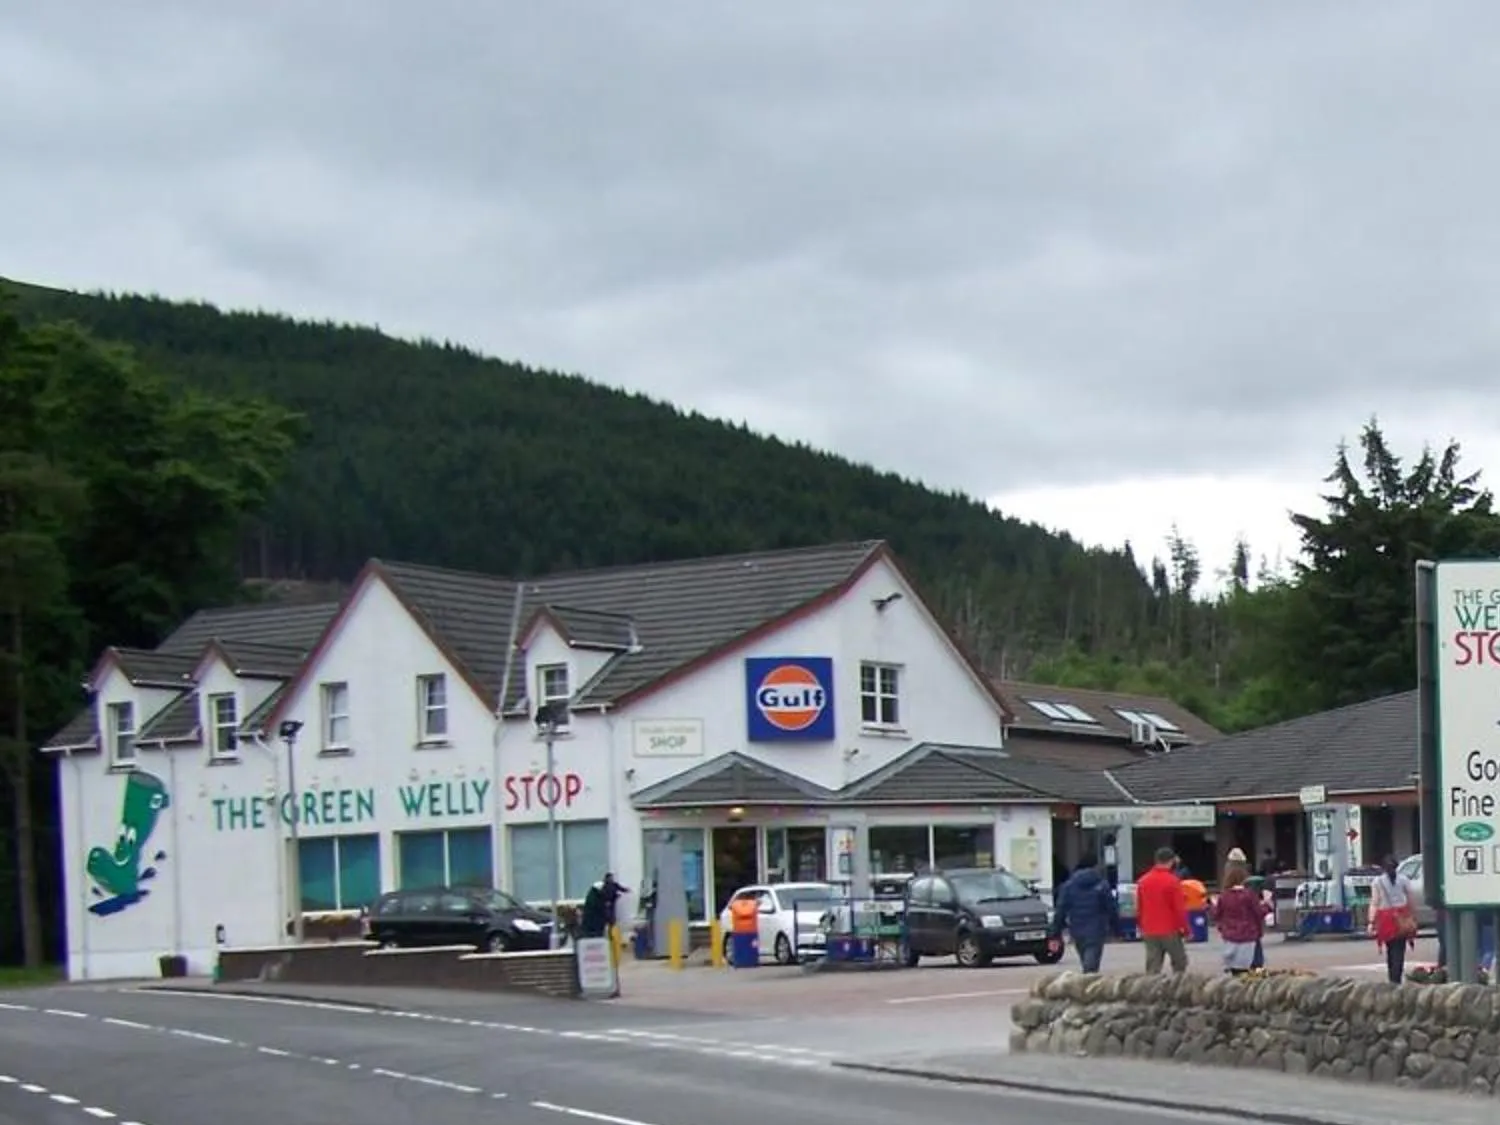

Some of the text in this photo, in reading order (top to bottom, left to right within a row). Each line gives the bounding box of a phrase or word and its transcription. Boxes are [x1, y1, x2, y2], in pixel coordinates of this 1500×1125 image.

[1453, 588, 1483, 604] THE
[758, 687, 824, 708] Gulf
[212, 773, 583, 831] THE GREEN WELLY STOP
[1451, 787, 1495, 817] Fine
